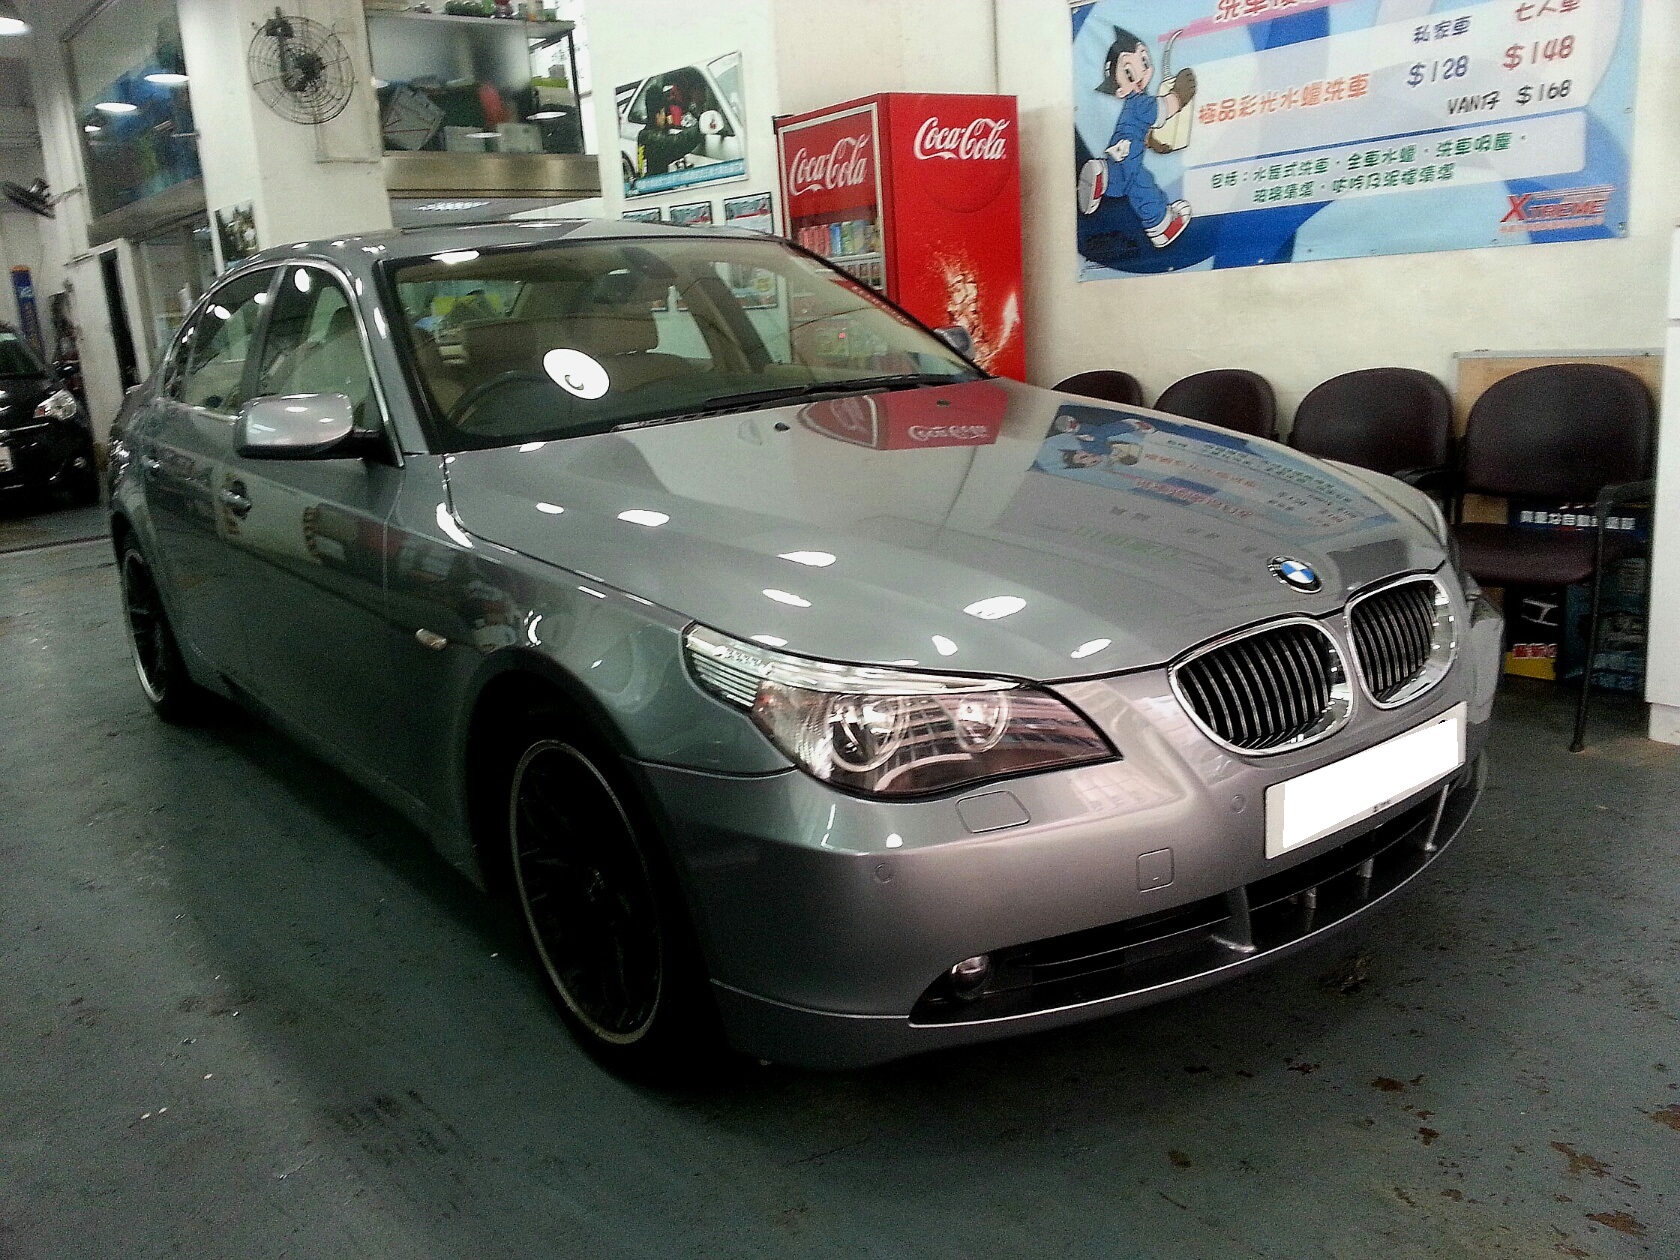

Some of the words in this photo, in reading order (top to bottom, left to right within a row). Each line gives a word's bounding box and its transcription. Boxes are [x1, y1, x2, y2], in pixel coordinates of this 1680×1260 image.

[1406, 54, 1469, 88] $128
[1502, 34, 1576, 70] $148
[1515, 79, 1573, 105] $168
[913, 116, 1011, 160] Coca-Cola
[789, 133, 871, 196] Coca-Cola
